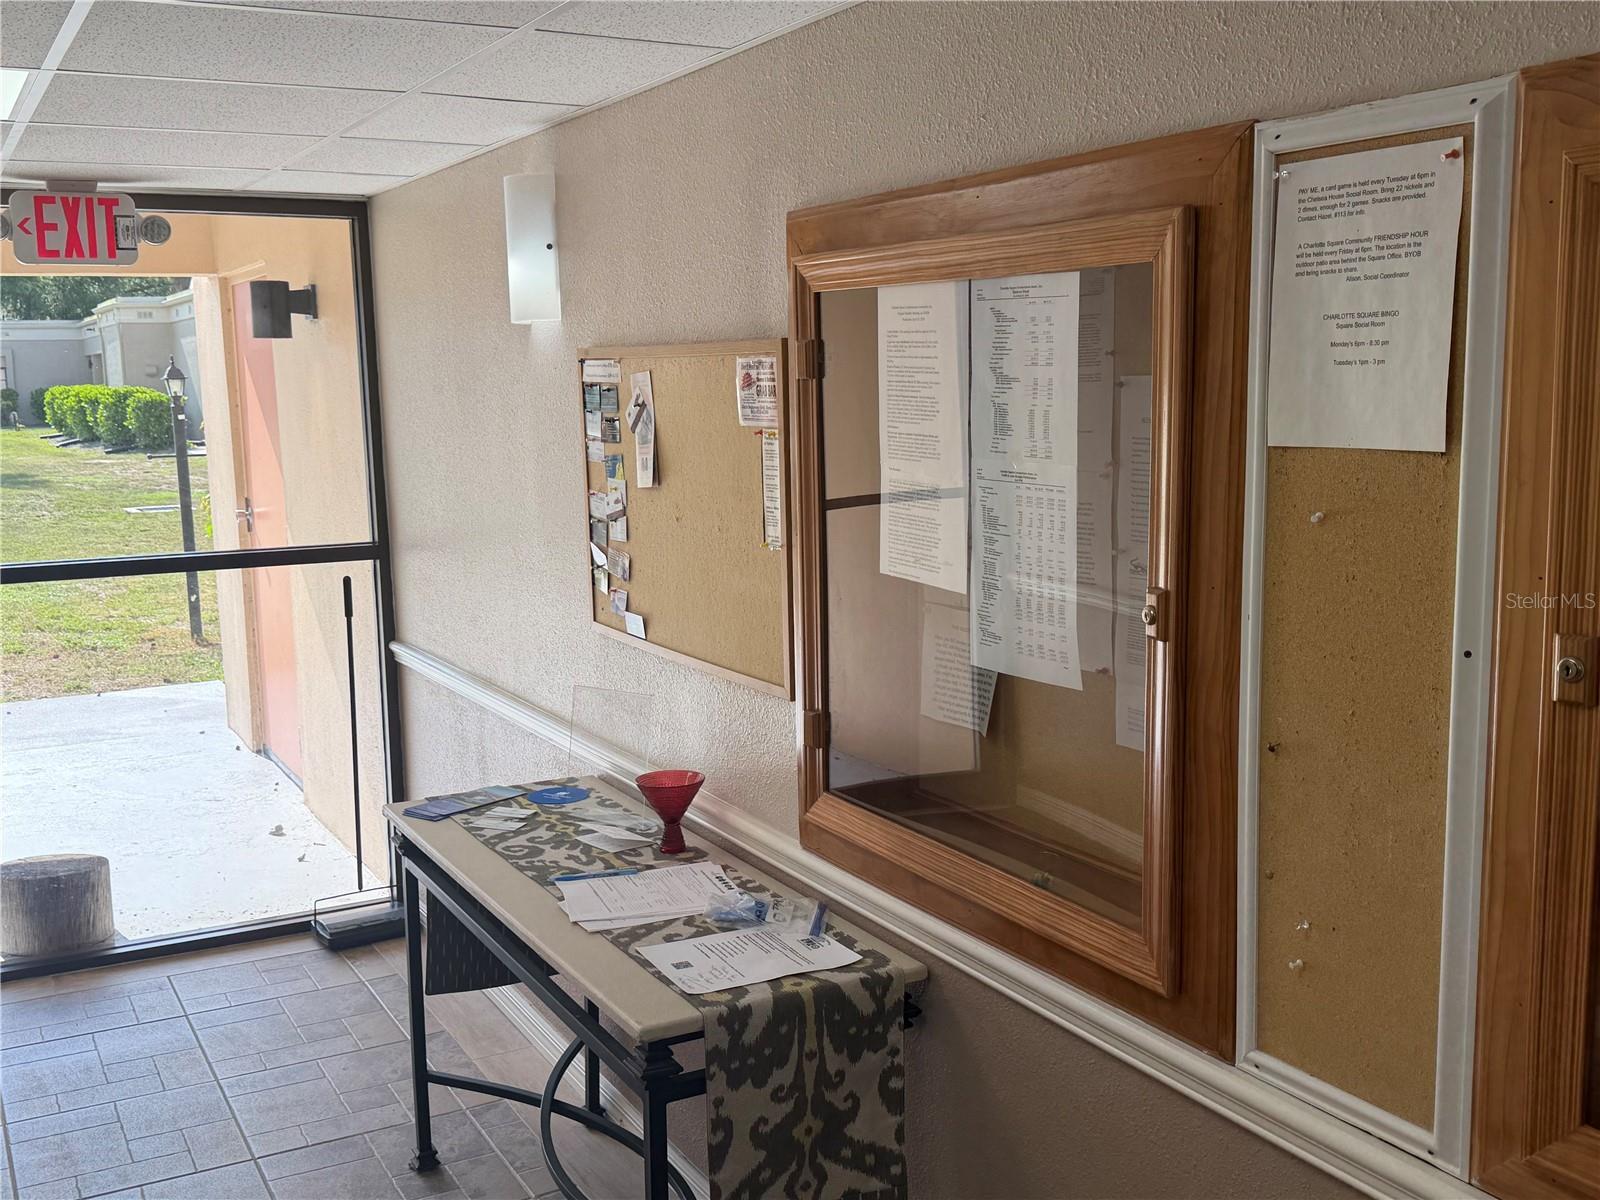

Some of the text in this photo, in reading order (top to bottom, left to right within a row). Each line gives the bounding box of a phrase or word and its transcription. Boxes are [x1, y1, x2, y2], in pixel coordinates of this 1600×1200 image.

[1298, 214, 1317, 222] Contact
[33, 195, 120, 259] EXIT
[1345, 237, 1373, 245] Community
[1374, 232, 1409, 241] FRIENDSHIP
[1323, 312, 1355, 320] CHARLOTTE
[1357, 311, 1380, 319] SQUARE
[1331, 340, 1353, 348] Monday's
